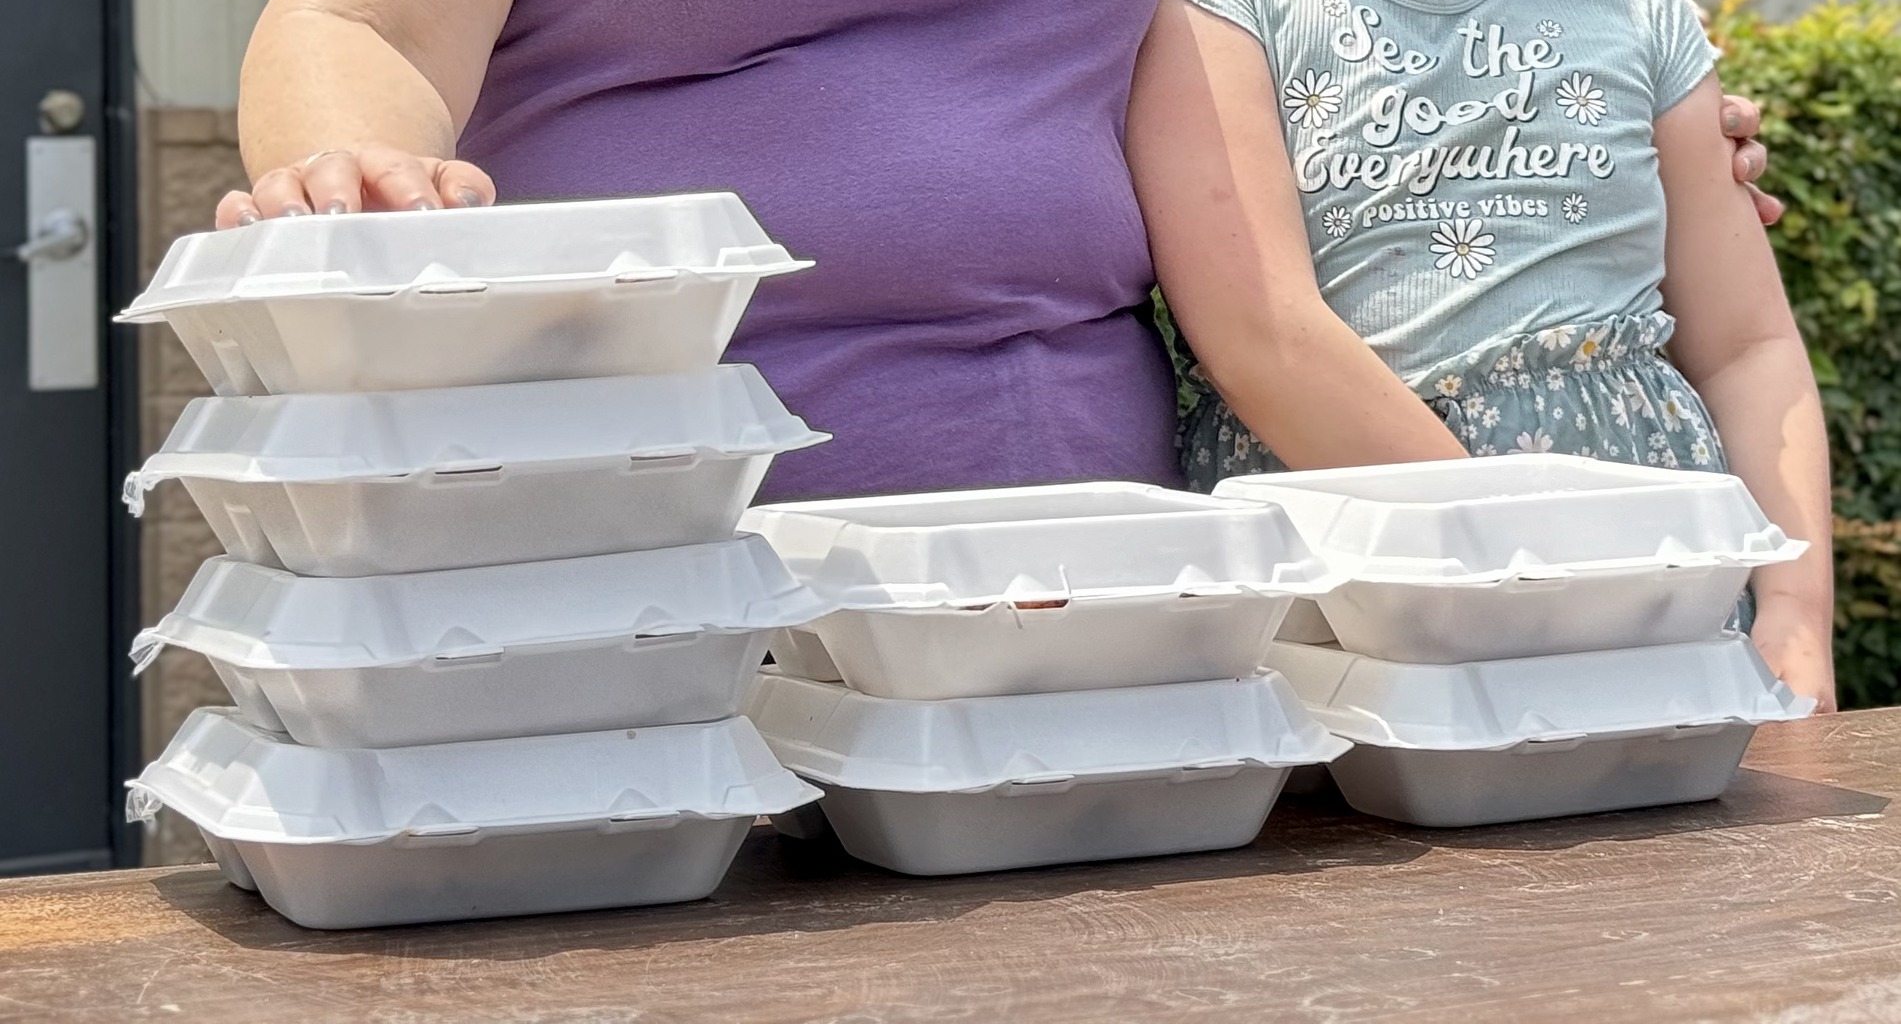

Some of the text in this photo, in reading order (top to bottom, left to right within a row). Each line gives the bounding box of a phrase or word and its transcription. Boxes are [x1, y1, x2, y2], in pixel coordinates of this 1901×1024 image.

[1330, 5, 1564, 79] See the
[1362, 71, 1538, 148] good
[1293, 126, 1615, 196] Everywhere
[1362, 193, 1549, 228] positive vibes
